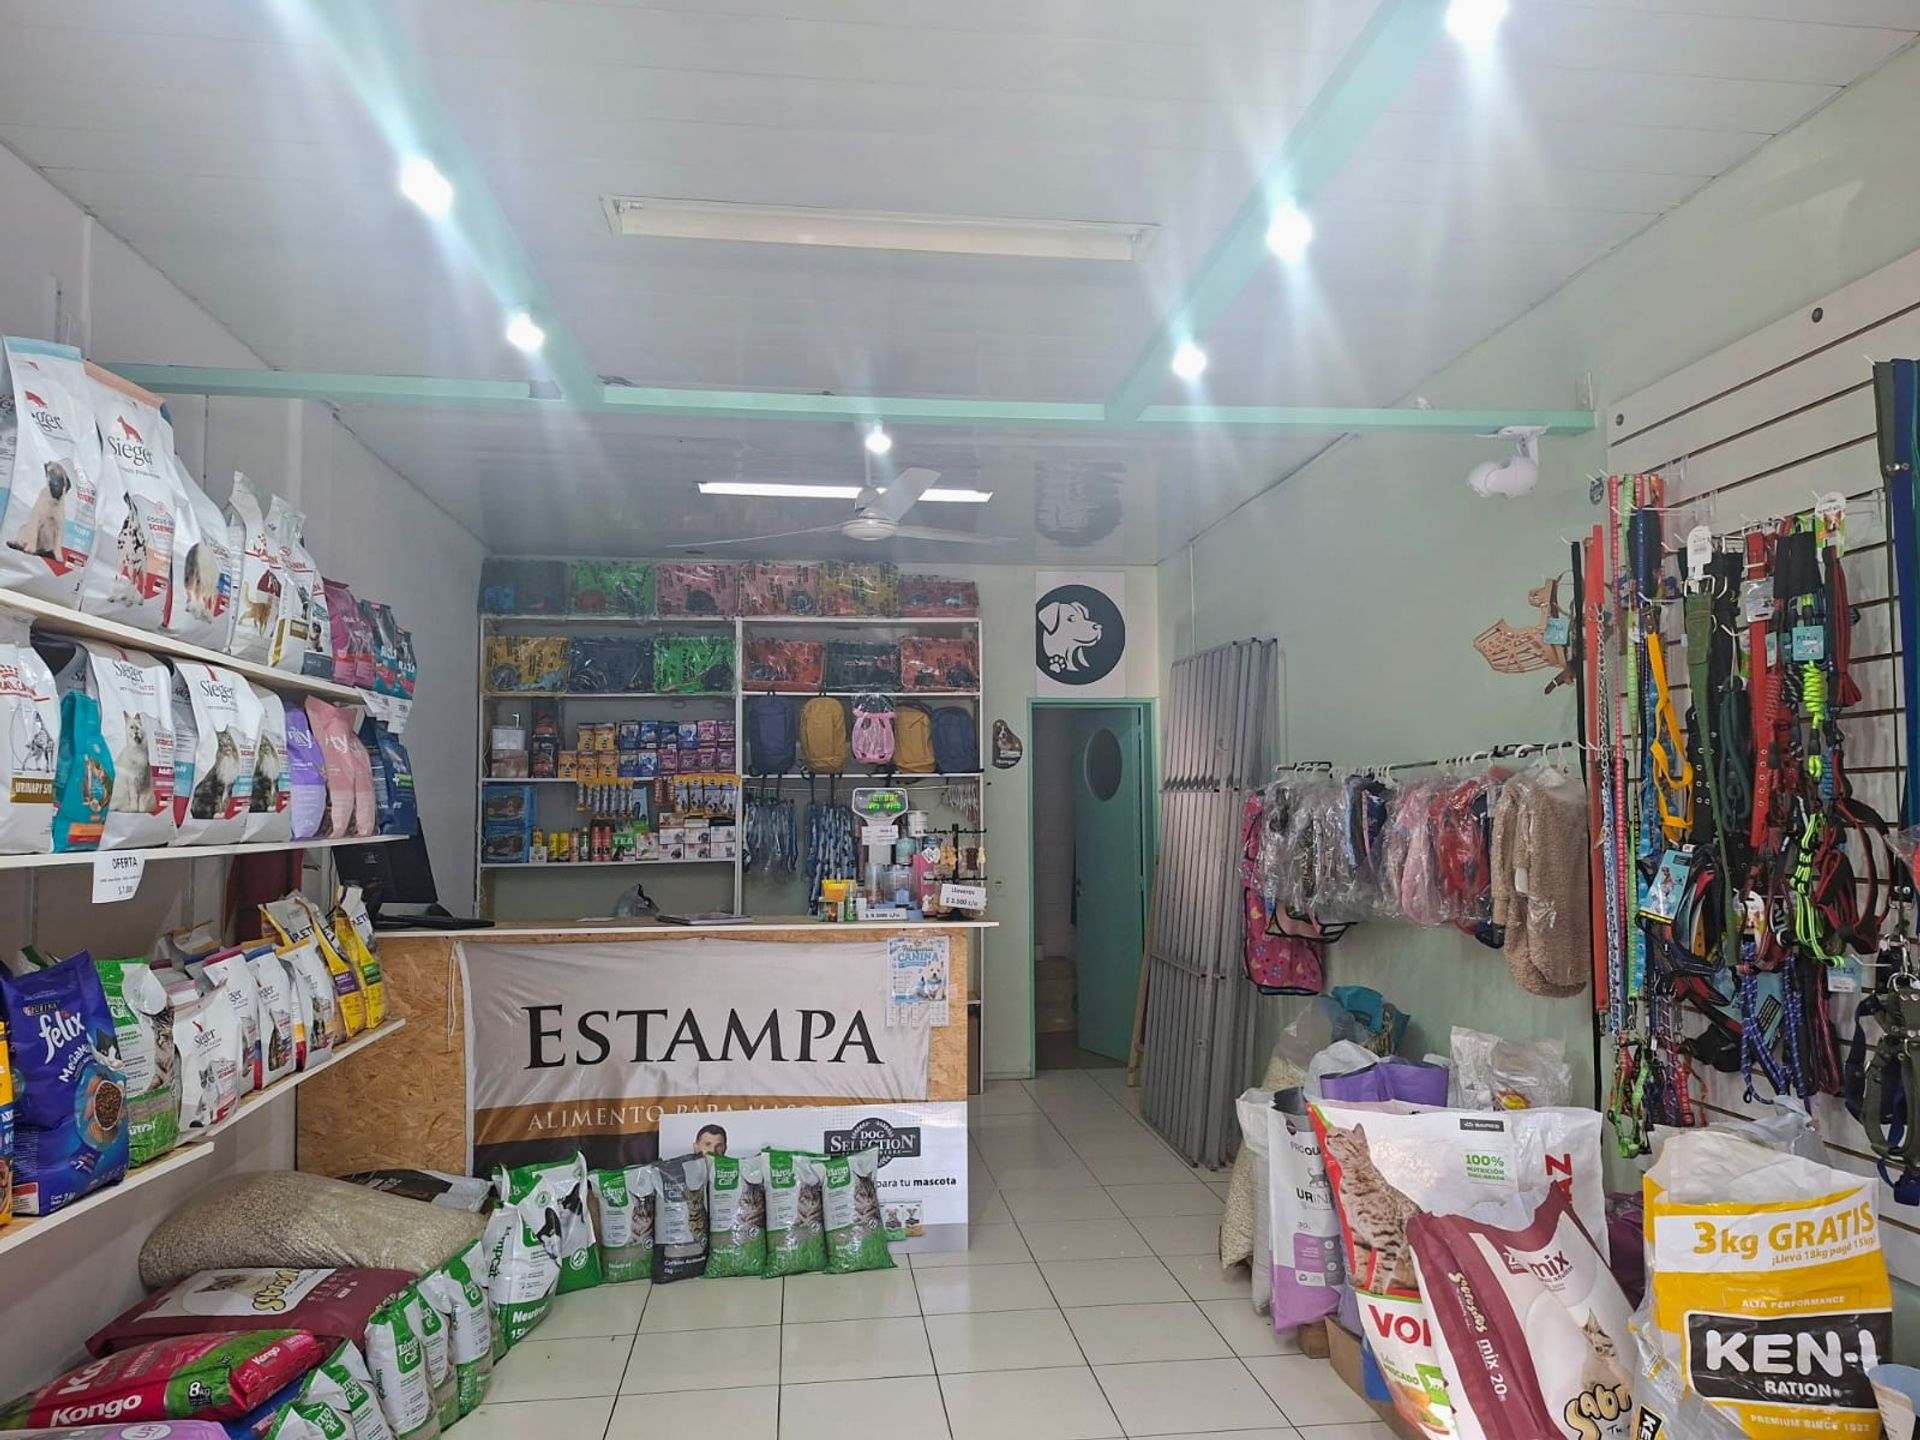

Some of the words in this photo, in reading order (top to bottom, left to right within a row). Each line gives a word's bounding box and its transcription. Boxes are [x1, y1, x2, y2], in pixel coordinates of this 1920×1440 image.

[898, 952, 939, 961] CANINA
[39, 1011, 86, 1064] felix
[521, 1003, 886, 1070] ESTAMPA
[527, 1104, 664, 1132] ALIMENTO
[830, 1134, 915, 1153] SELECTION
[860, 1130, 886, 1139] DOG
[1465, 1154, 1504, 1167] 100%
[900, 1177, 911, 1187] tu
[913, 1177, 957, 1187] mascota
[1767, 1201, 1876, 1252] GRATIS
[1528, 1250, 1570, 1277] mix
[1742, 1297, 1768, 1309] ALTA
[1770, 1295, 1846, 1309] PERFORMANCE
[251, 1346, 280, 1365] Kongo
[1477, 1339, 1500, 1370] mix
[1764, 1379, 1832, 1398] RATION
[51, 1394, 142, 1427] Kongo
[1750, 1414, 1800, 1428] PREMIUM
